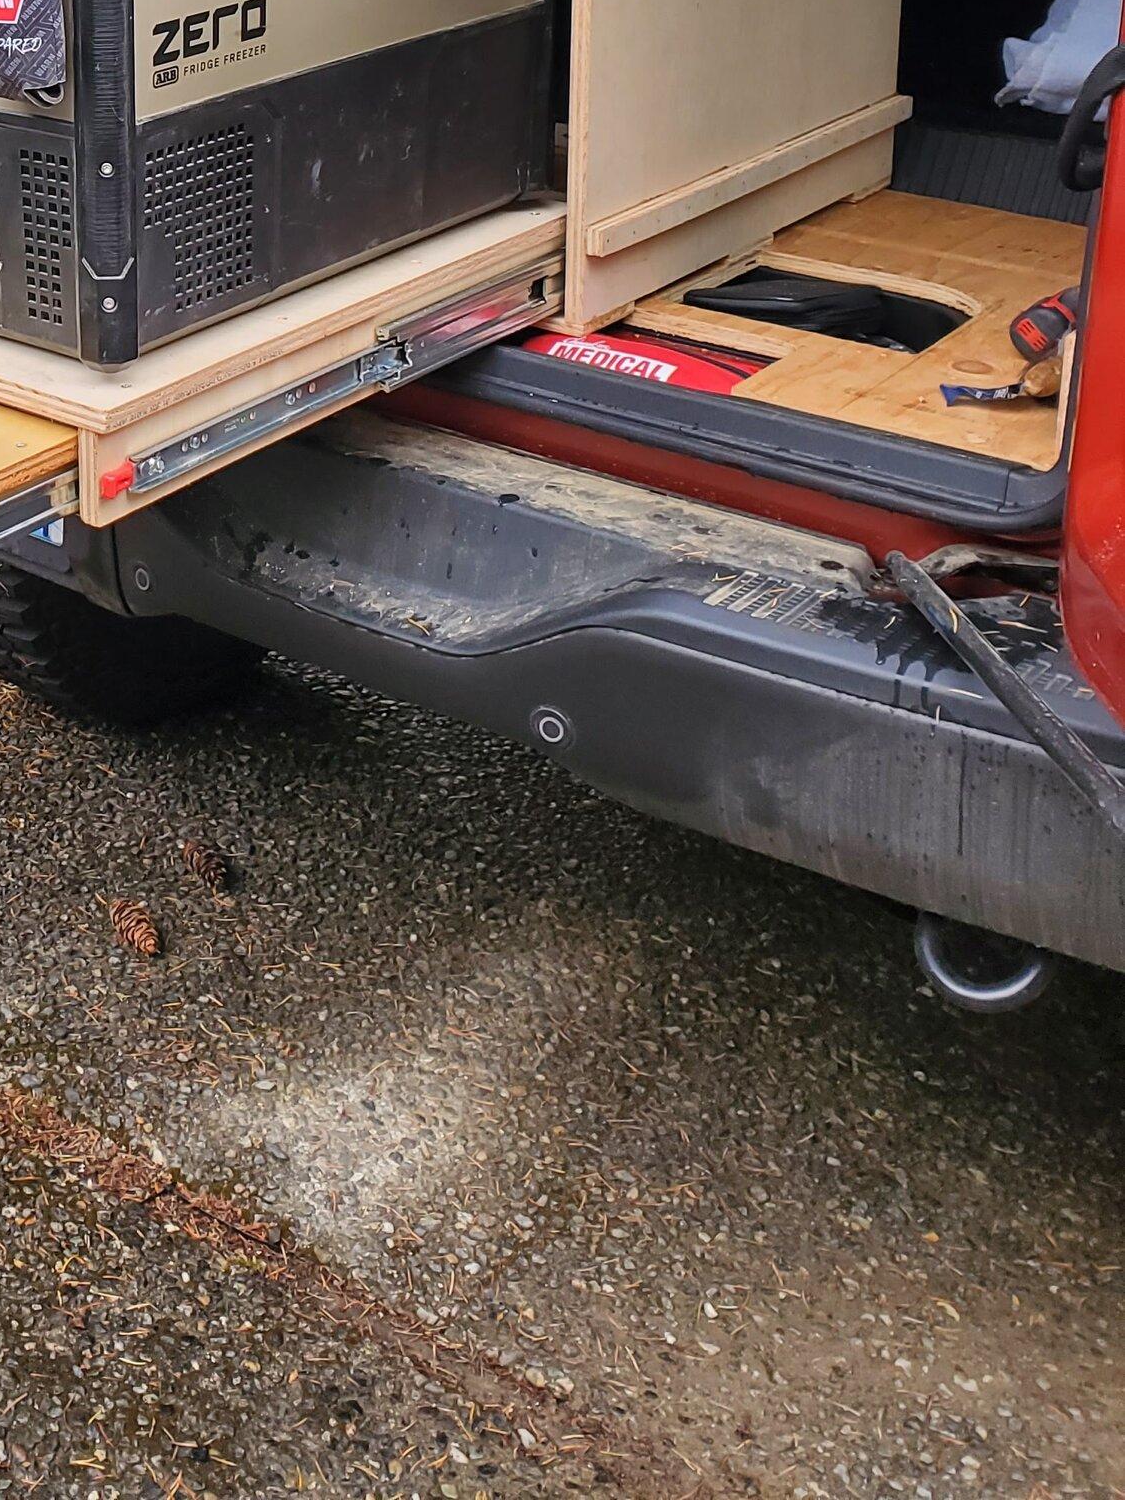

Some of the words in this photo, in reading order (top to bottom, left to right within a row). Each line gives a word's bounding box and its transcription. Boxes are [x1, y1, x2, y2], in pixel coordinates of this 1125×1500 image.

[35, 53, 56, 77] WARN
[183, 57, 220, 76] FRIDGE
[223, 44, 266, 63] FREEZER
[156, 70, 176, 85] ARB
[555, 345, 663, 380] MEDICAL
